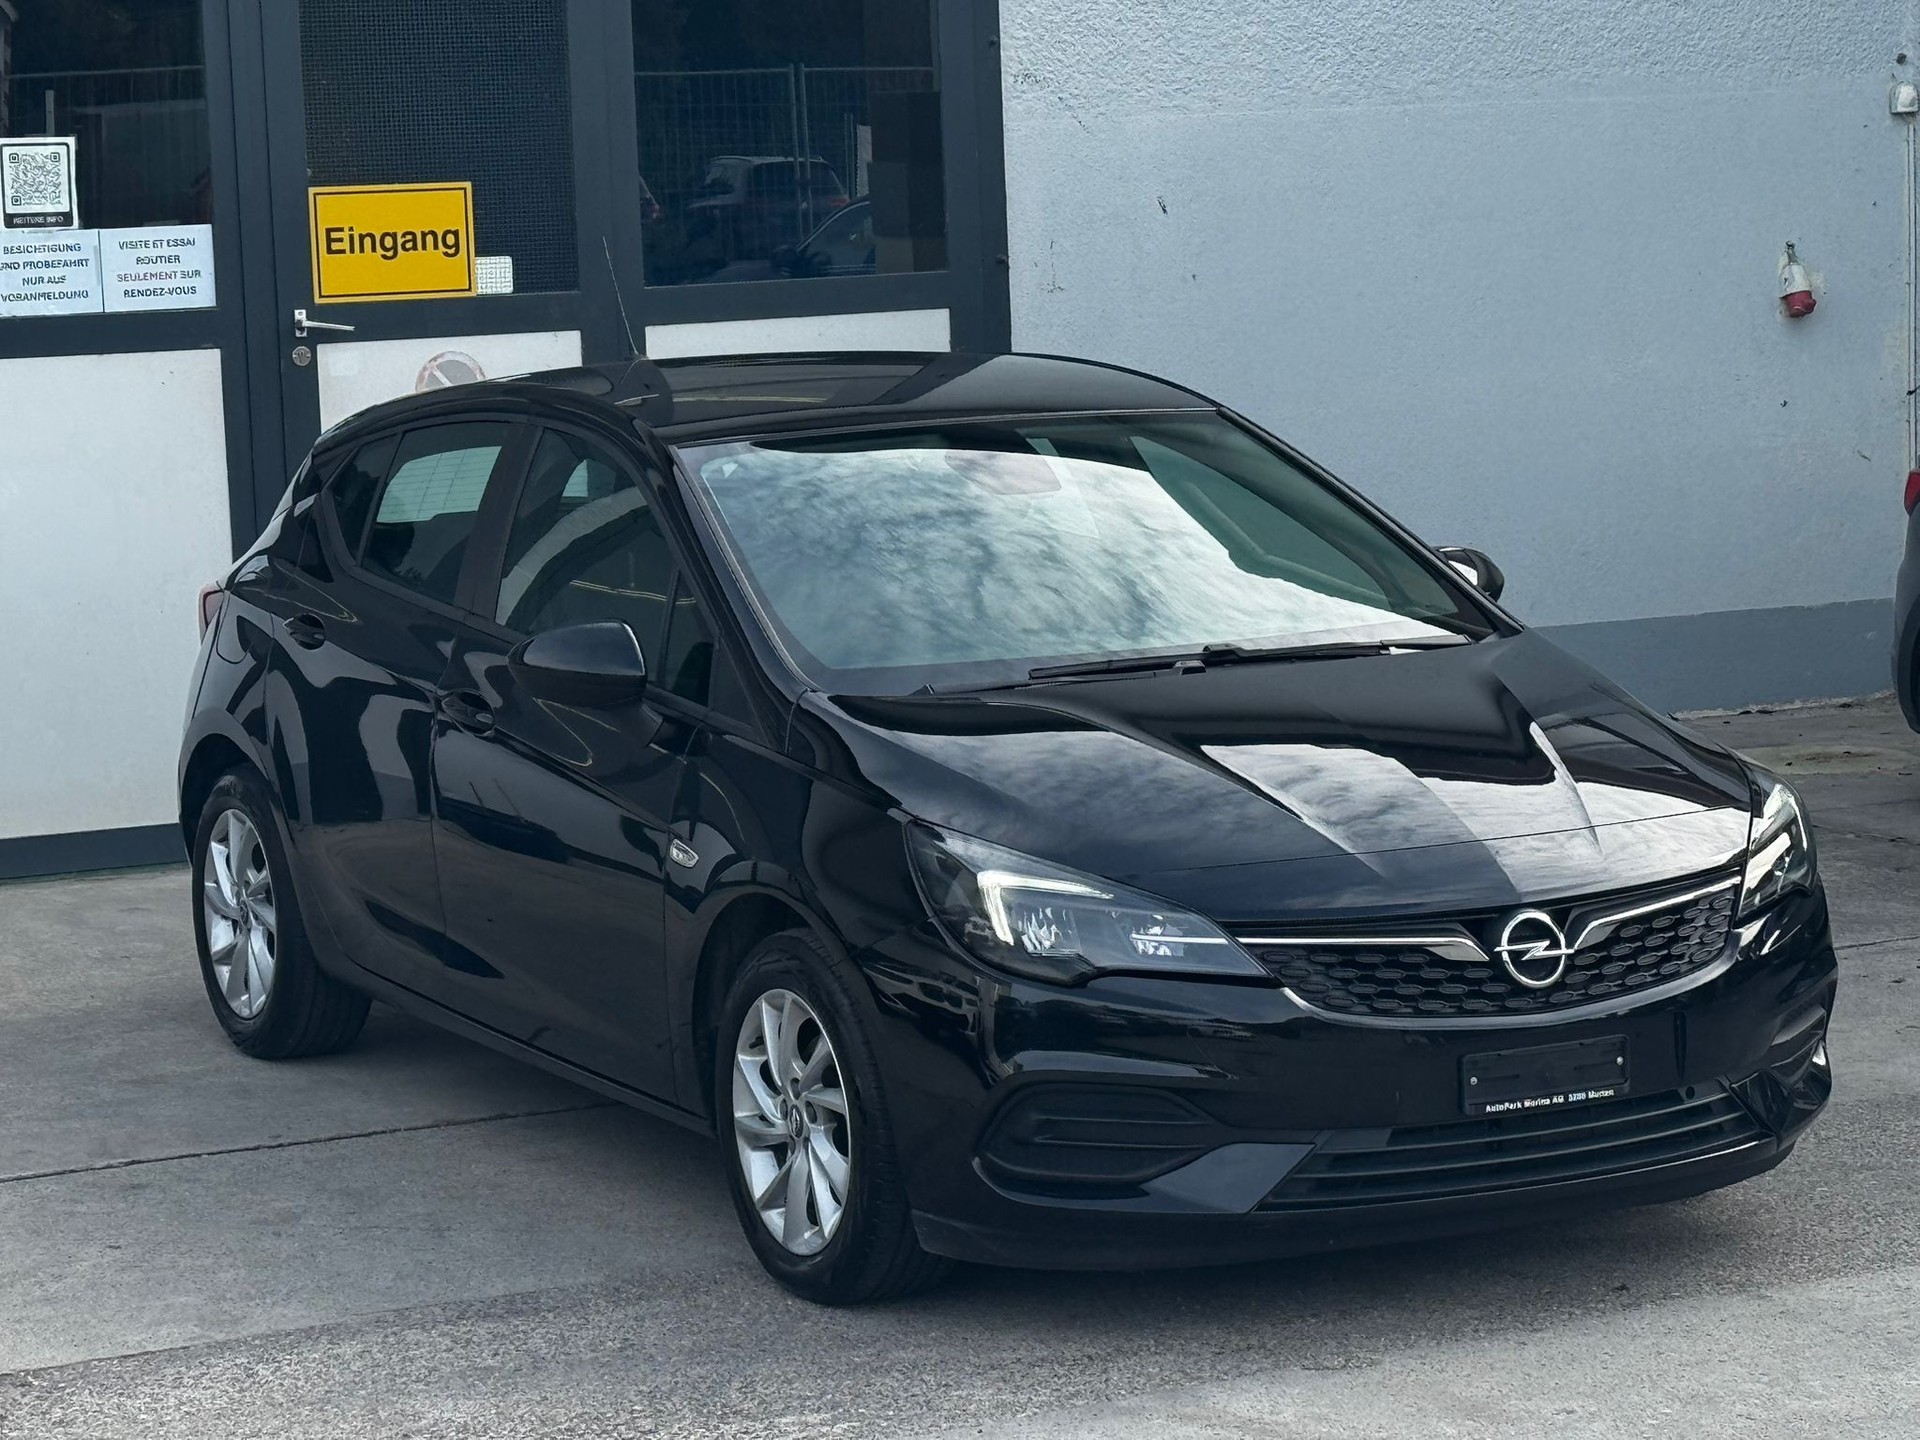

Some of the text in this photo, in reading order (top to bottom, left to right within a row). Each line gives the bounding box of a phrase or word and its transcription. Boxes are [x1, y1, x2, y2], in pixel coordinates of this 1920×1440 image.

[3, 243, 82, 255] BESICHTIGUNG
[118, 237, 196, 250] VISITE ET ESSAI
[325, 226, 460, 260] Eingang
[22, 258, 90, 270] PROBEFAHRT
[136, 254, 181, 265] ROUTIER
[22, 276, 44, 287] NUR
[116, 269, 202, 282] SEULEMENT SUR
[0, 289, 89, 302] VORANMELDUNG
[123, 285, 197, 298] RENDEZ-VOUS
